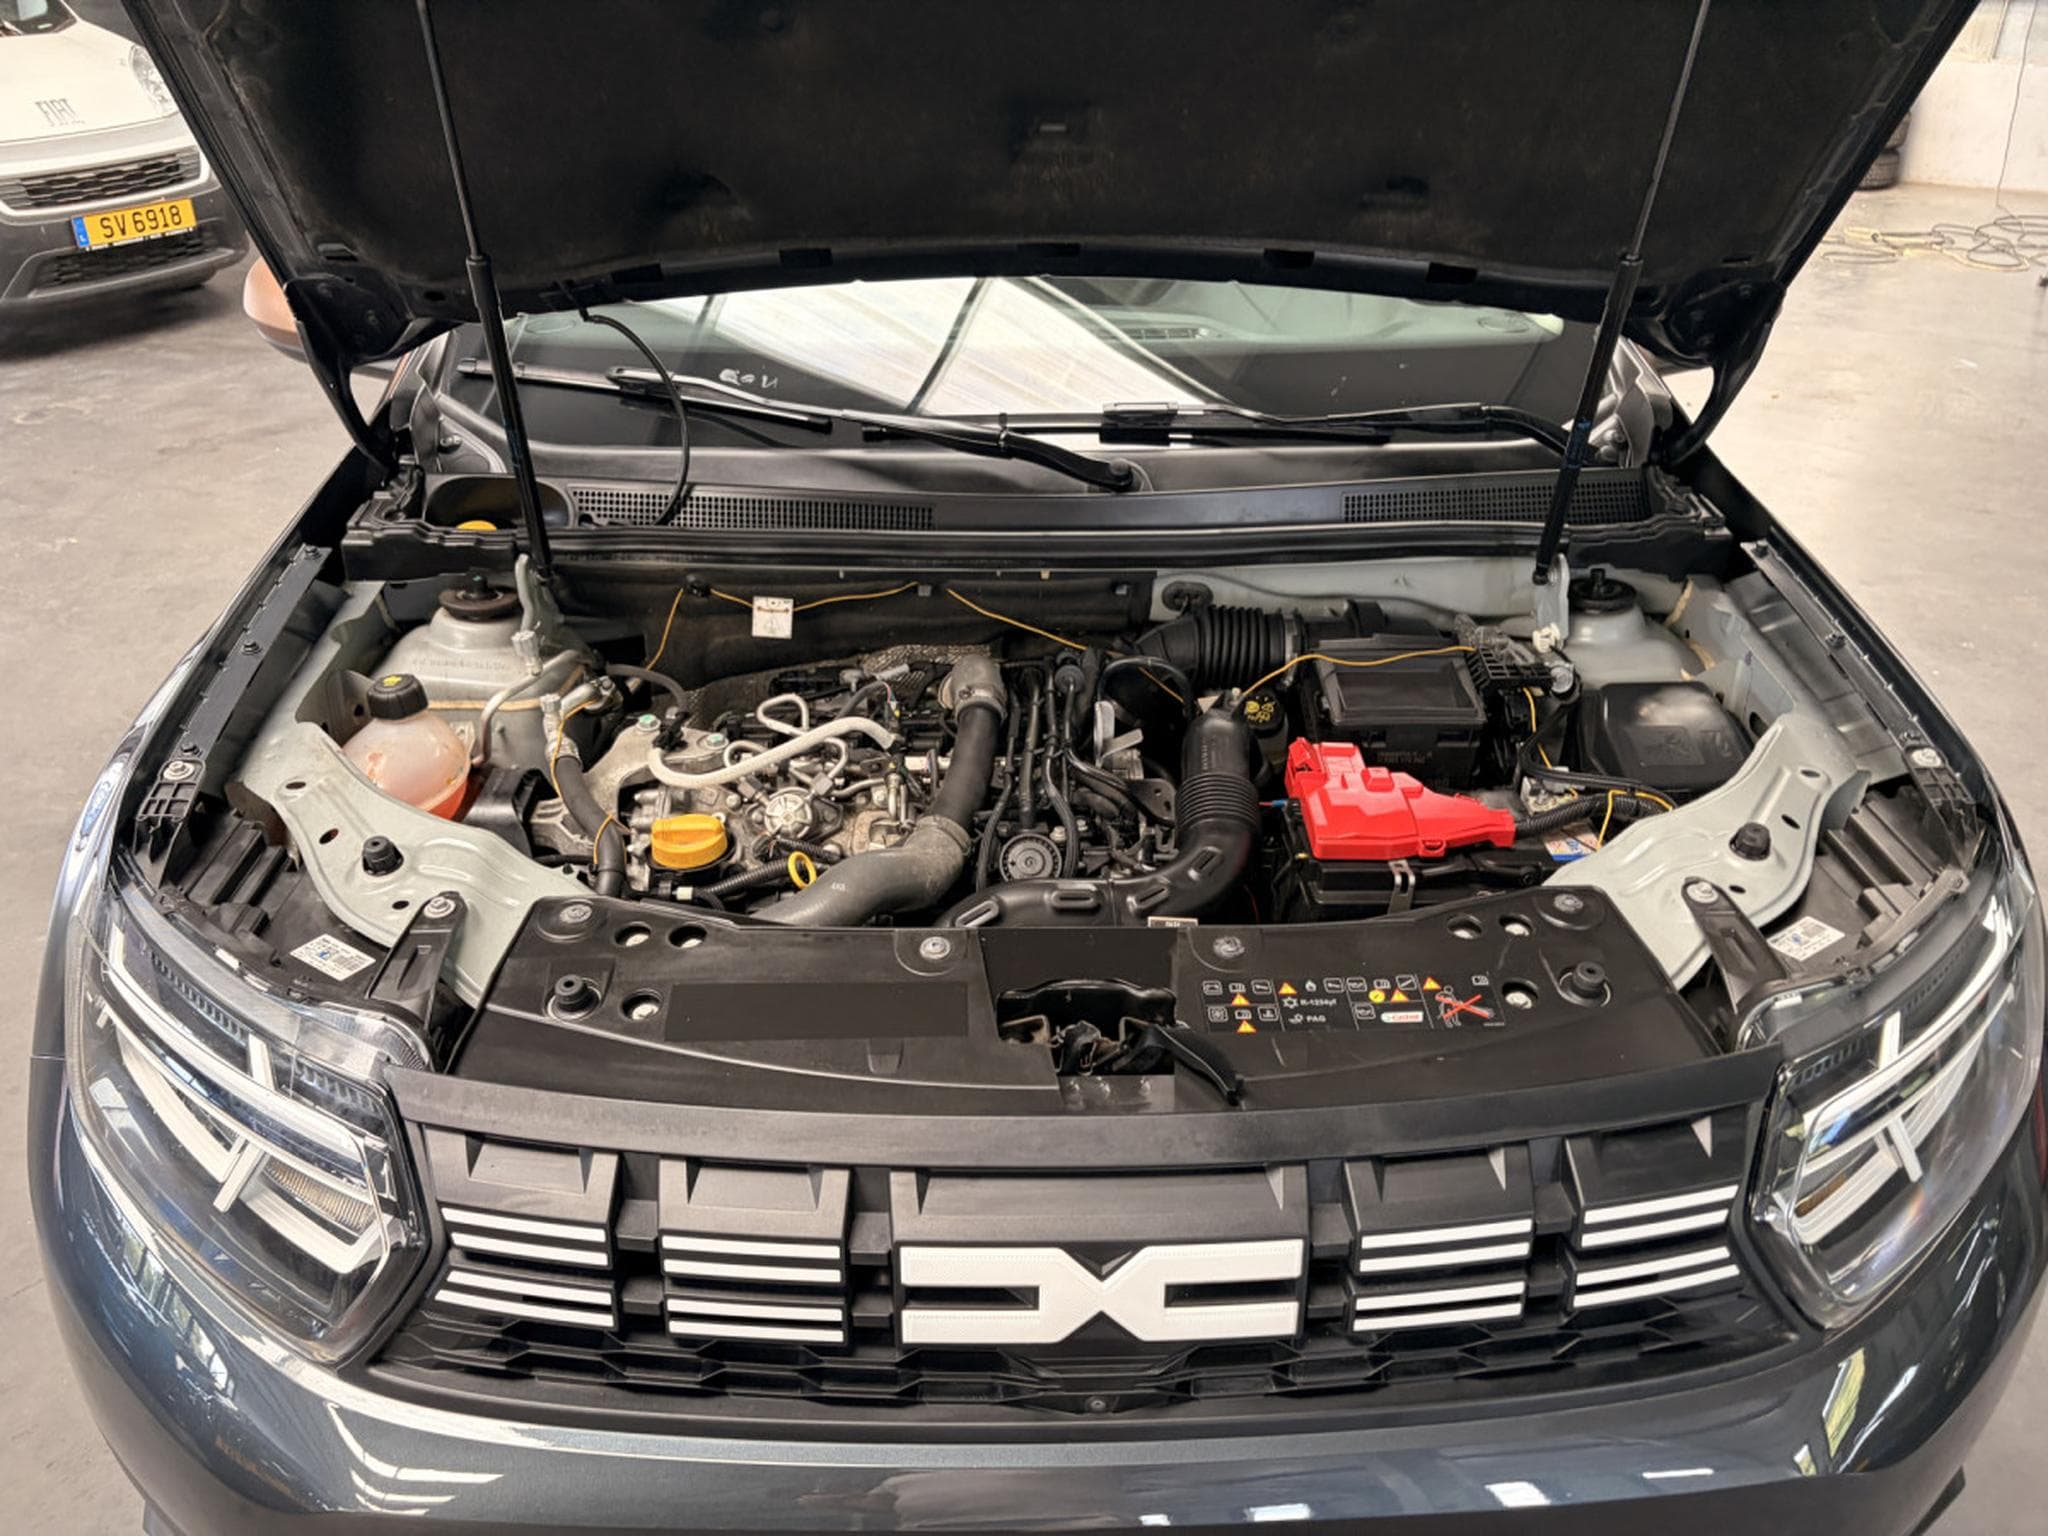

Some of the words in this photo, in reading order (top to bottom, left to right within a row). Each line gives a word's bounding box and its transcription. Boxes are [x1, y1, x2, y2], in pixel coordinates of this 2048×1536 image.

[35, 98, 86, 127] FIAT
[100, 214, 126, 238] SV
[132, 205, 182, 232] 6918
